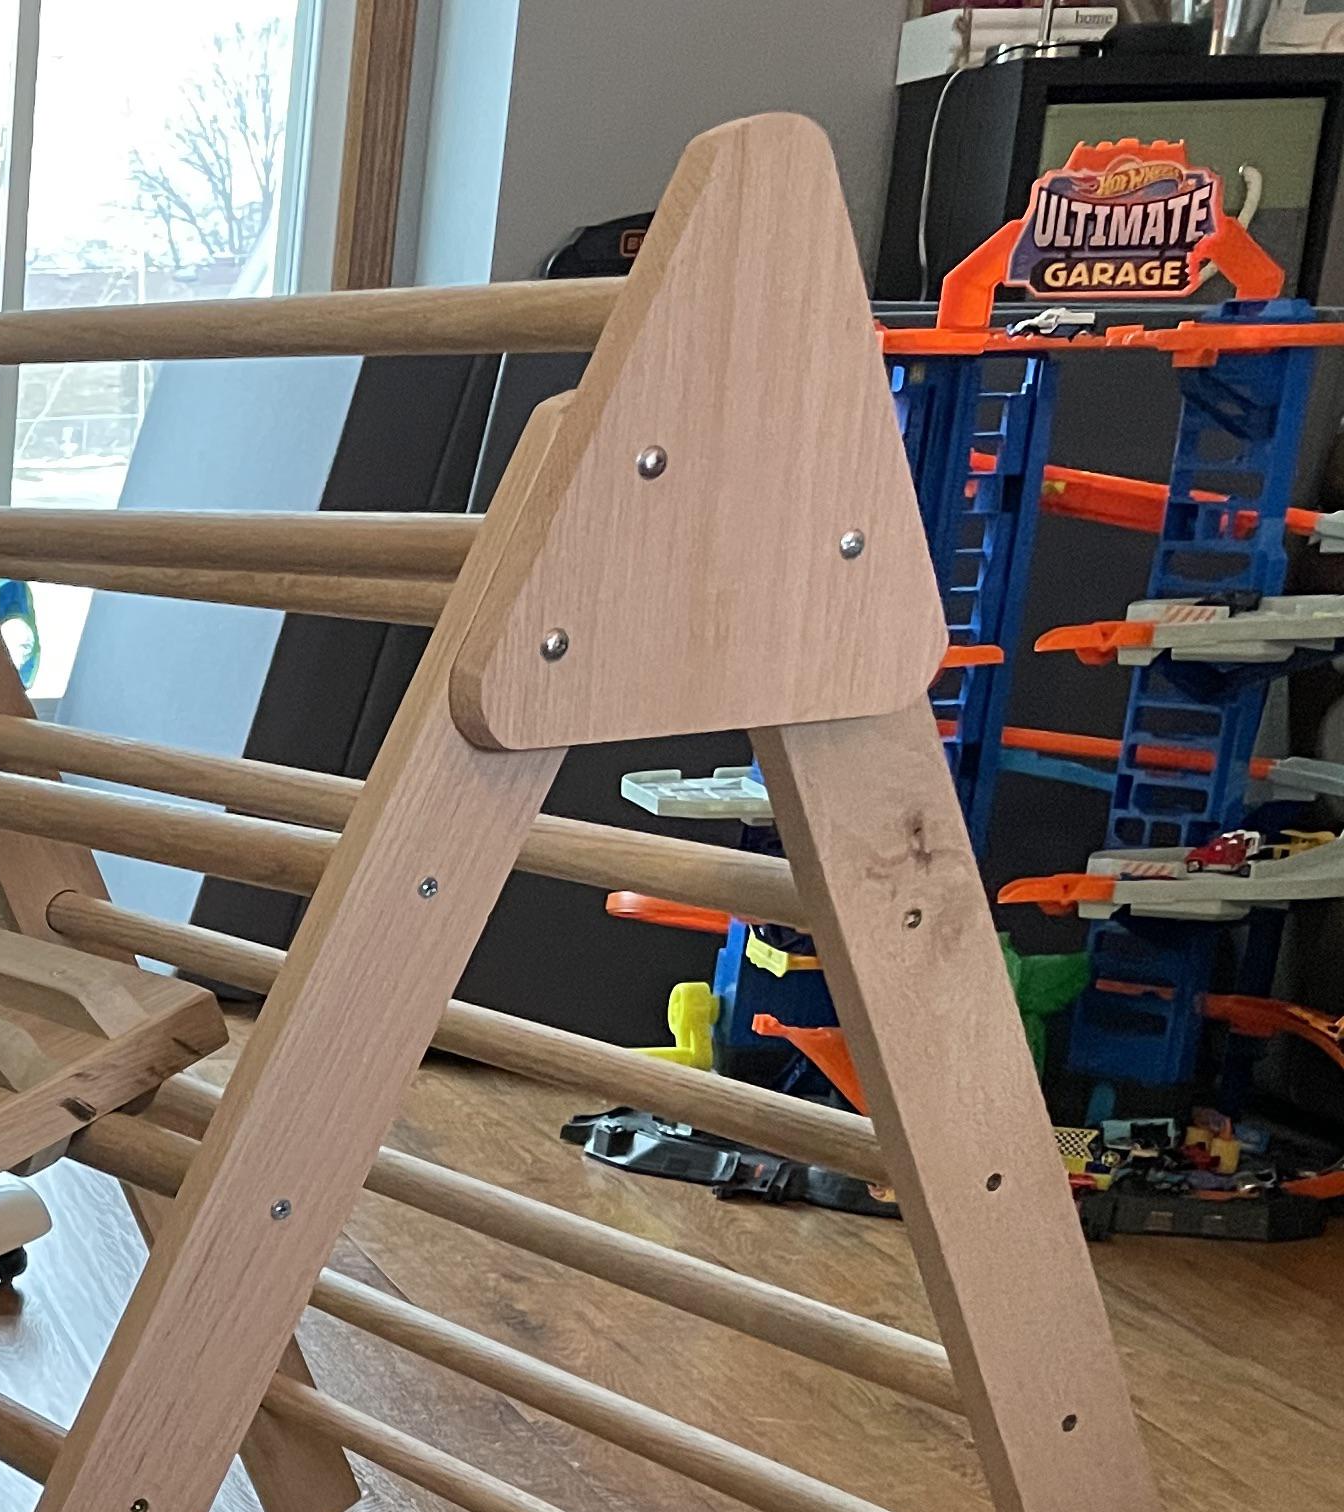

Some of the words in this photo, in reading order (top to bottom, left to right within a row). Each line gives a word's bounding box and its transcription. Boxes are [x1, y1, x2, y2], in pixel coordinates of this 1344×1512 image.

[1074, 10, 1113, 26] home
[1033, 182, 1213, 248] ULTIMATE
[1043, 260, 1182, 288] GARAGE
